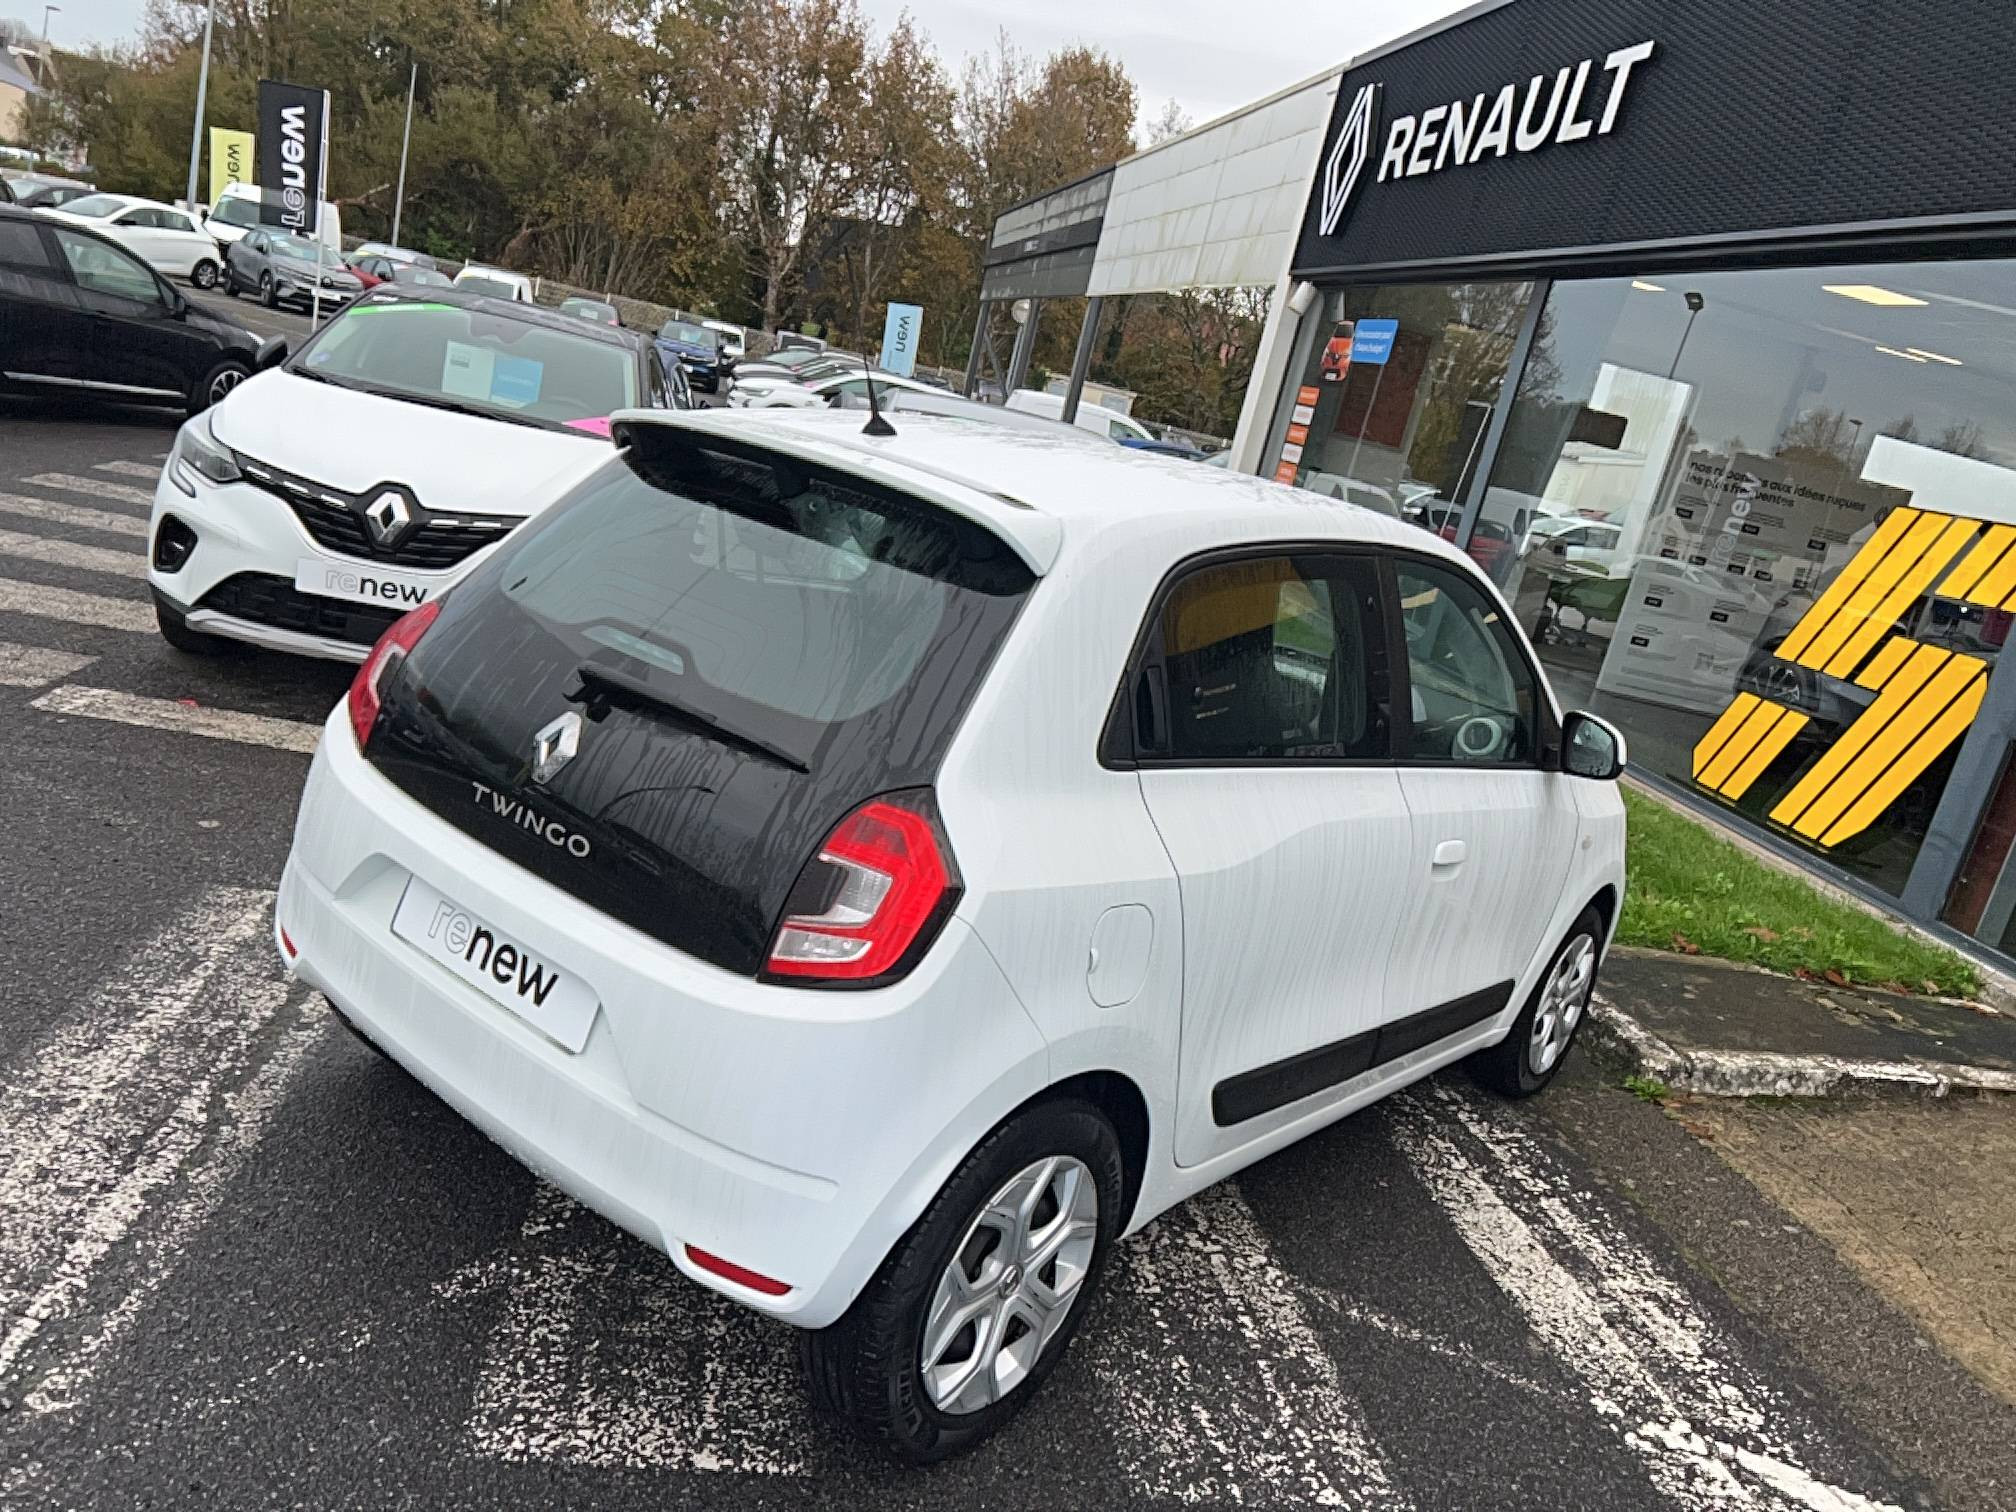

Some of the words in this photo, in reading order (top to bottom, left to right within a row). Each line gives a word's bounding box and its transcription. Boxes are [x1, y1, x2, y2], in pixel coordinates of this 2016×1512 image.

[1376, 40, 1656, 184] RENAULT
[1711, 472, 1761, 564] renew
[325, 568, 428, 604] renew
[472, 782, 591, 858] TWINGO
[428, 900, 559, 1007] renew
